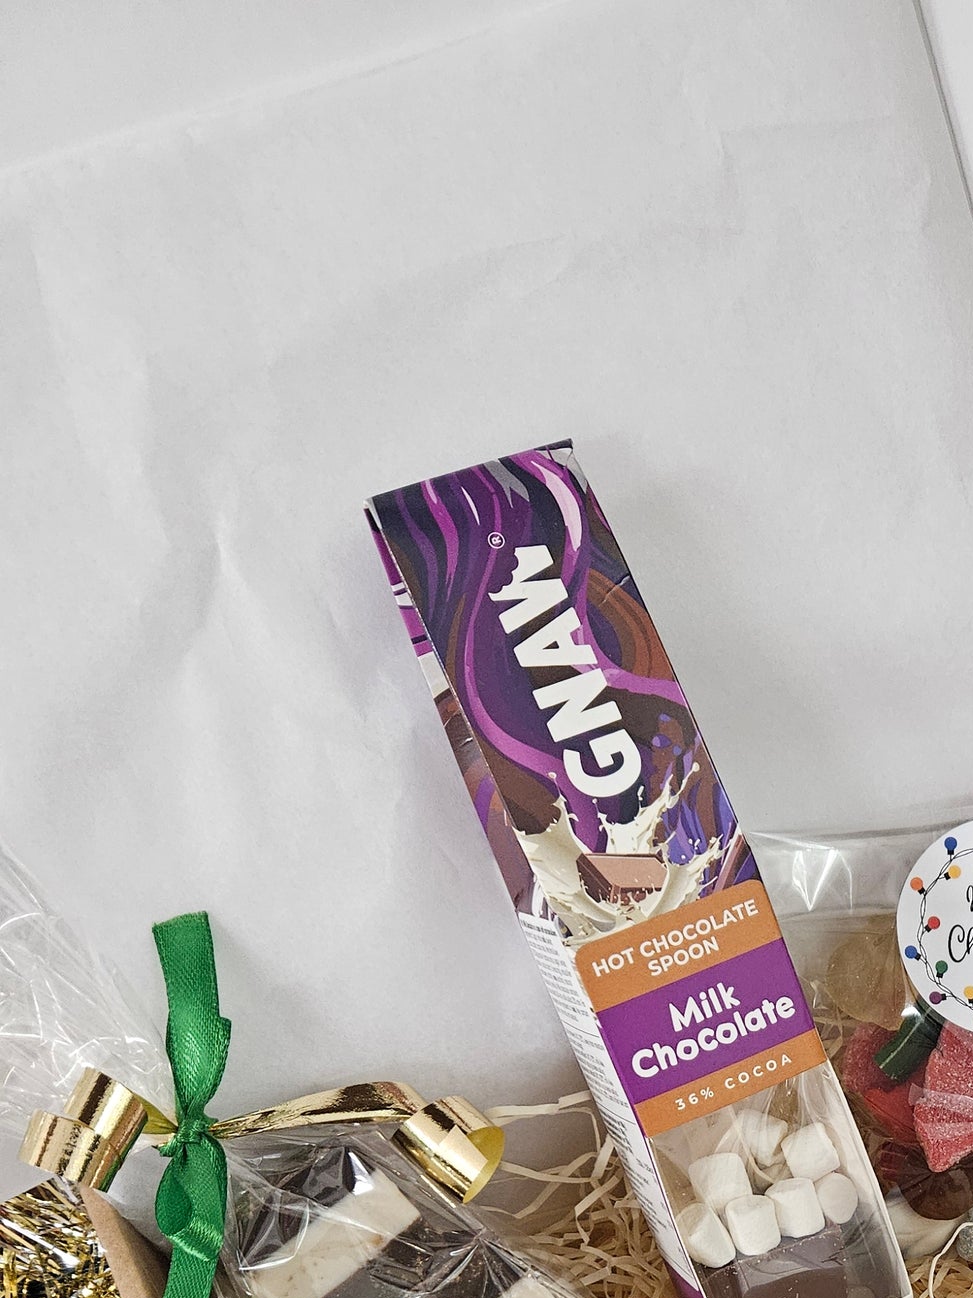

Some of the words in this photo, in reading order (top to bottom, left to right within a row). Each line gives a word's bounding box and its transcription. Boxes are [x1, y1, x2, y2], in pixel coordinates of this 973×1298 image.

[488, 545, 643, 798] GNAW
[592, 947, 636, 978] HOT
[639, 899, 760, 959] CHOCOLATE
[647, 936, 720, 977] SPOON
[631, 995, 796, 1079] Chocolate
[668, 982, 742, 1033] Milk
[675, 1086, 715, 1111] 36%
[724, 1053, 793, 1090] COCOA
